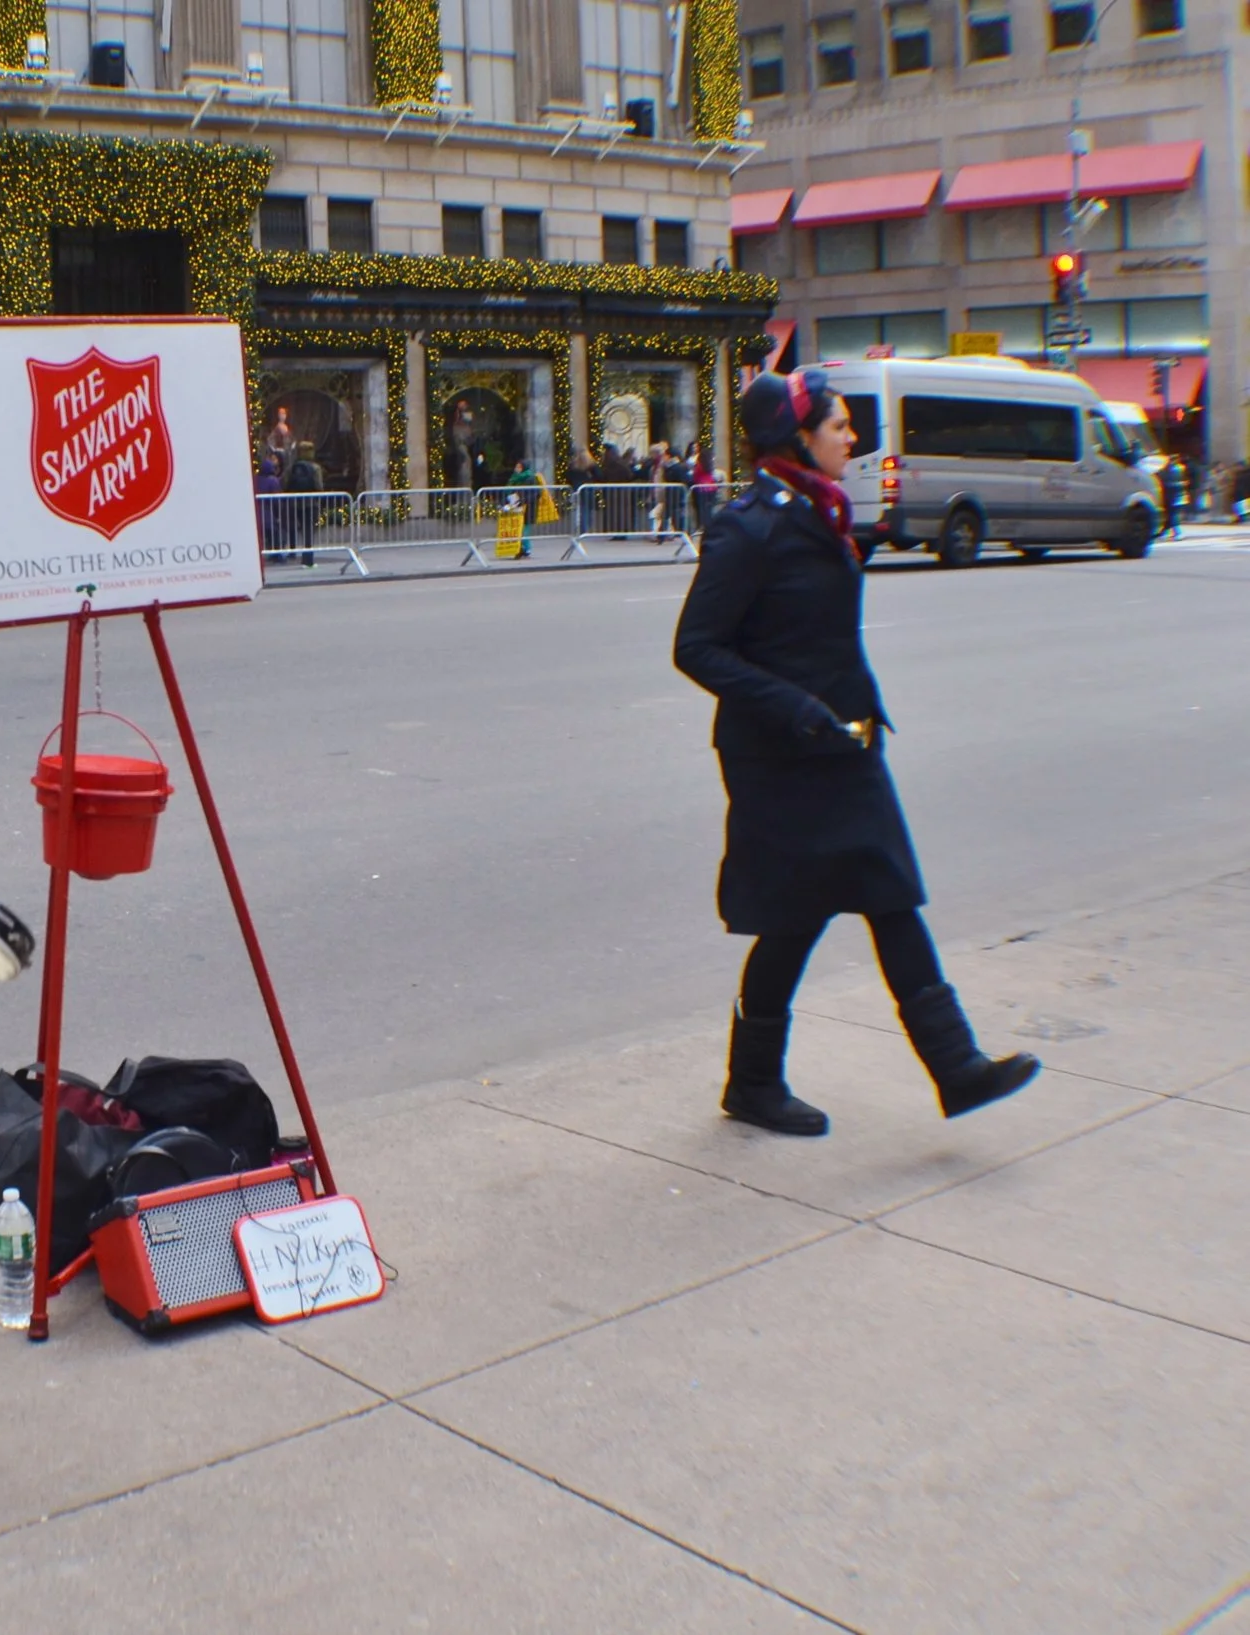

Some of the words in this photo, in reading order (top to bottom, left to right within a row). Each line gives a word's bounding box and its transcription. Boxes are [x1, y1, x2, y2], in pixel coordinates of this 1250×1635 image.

[41, 374, 152, 494] SALVATION
[53, 367, 105, 429] THE
[88, 427, 152, 517] ARMY
[66, 552, 106, 574] THE
[112, 547, 166, 570] MOST
[171, 542, 232, 564] GOOD
